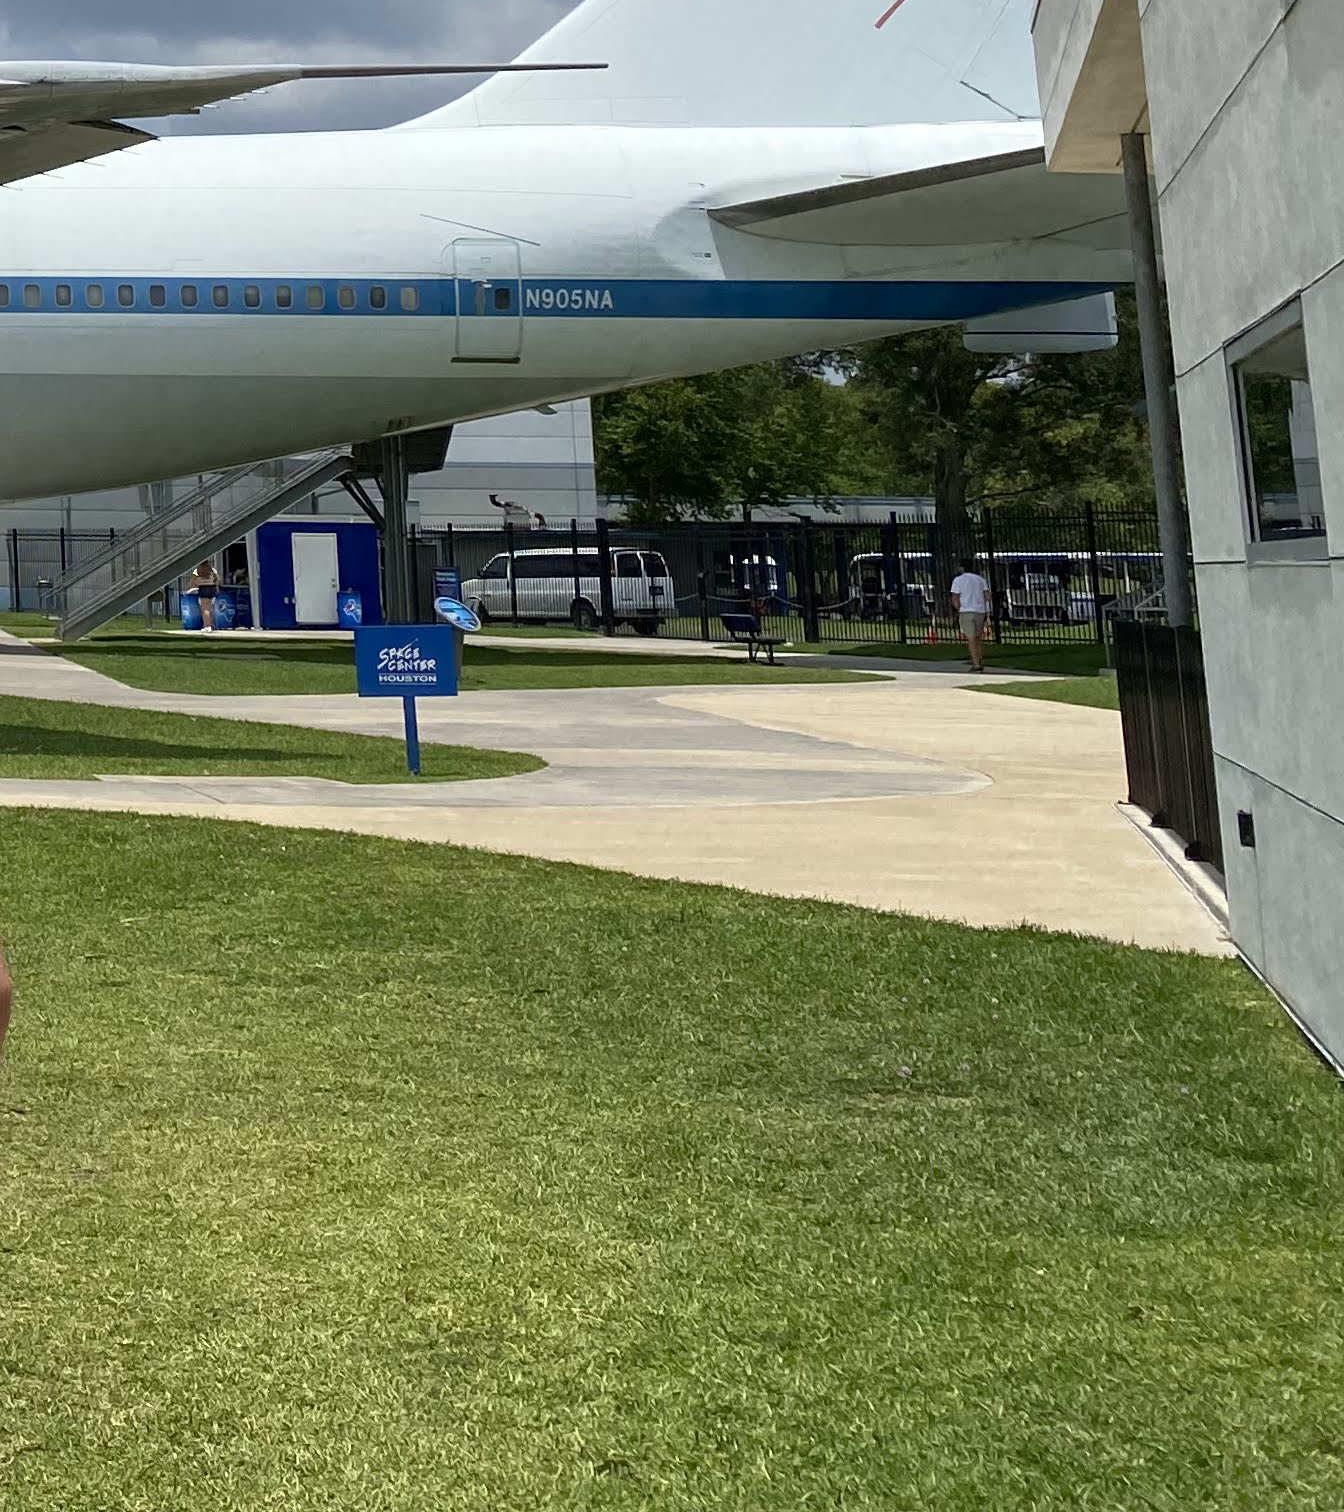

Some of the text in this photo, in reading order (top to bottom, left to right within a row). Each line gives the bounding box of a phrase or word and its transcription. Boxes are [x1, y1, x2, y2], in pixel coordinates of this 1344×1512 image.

[526, 288, 613, 309] N905NA
[377, 643, 420, 669] SPACE
[388, 659, 436, 671] CENTER
